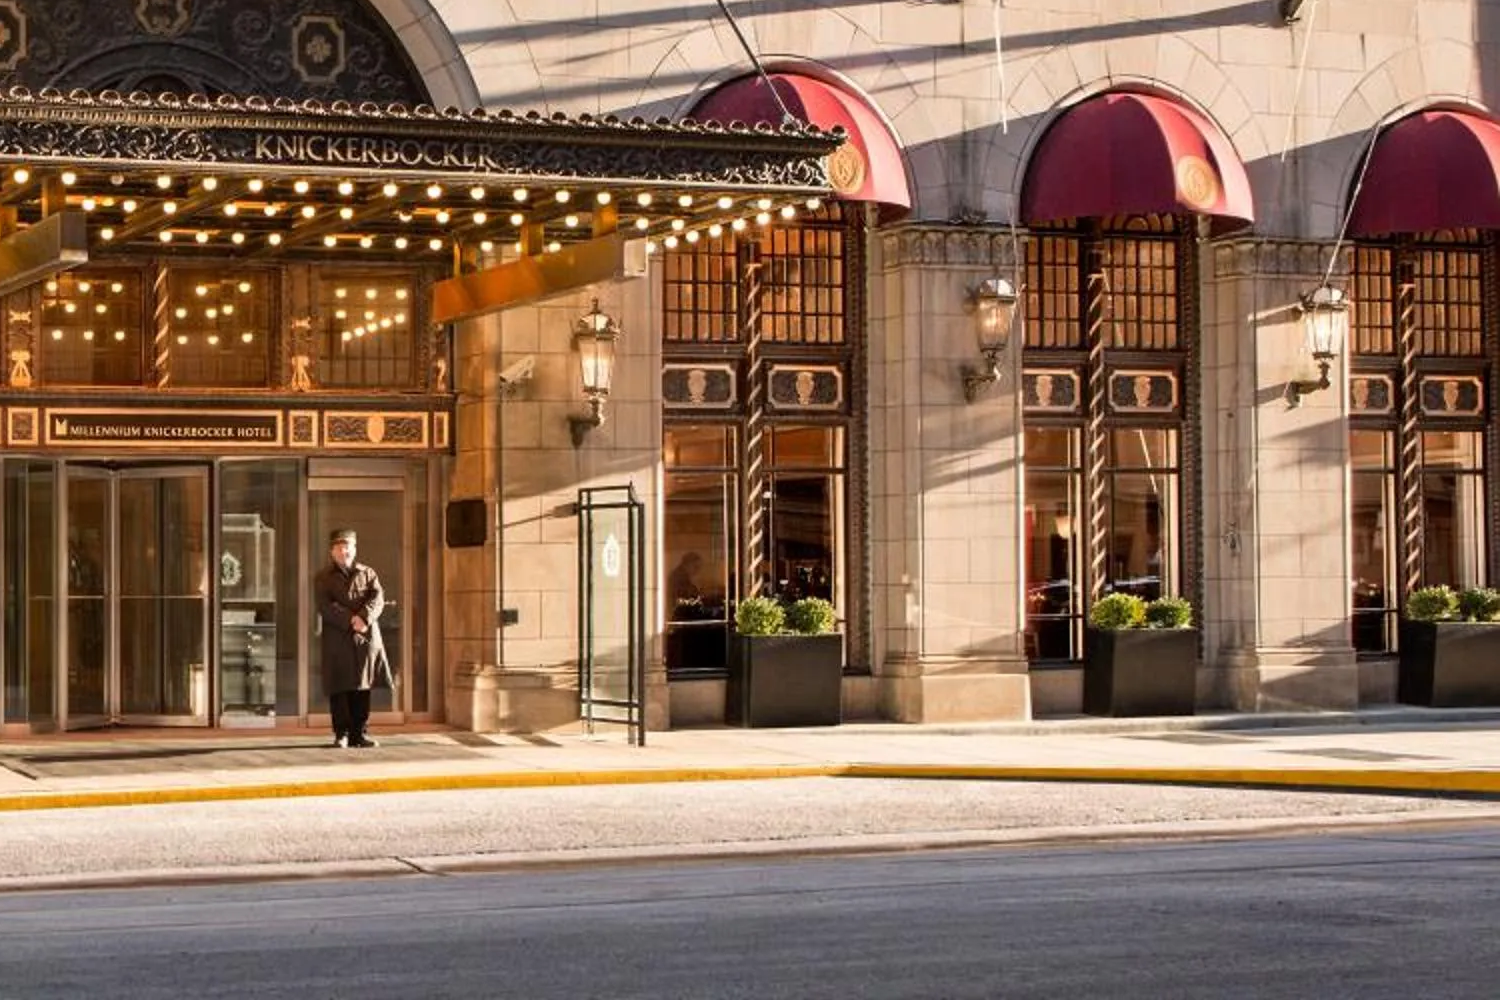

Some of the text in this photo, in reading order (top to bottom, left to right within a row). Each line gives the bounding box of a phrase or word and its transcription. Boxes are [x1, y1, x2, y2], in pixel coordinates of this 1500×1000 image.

[254, 133, 501, 169] KNICKERBOCKER
[70, 425, 273, 437] MILLENNIUM KNICKERBOCKER HOTEL
